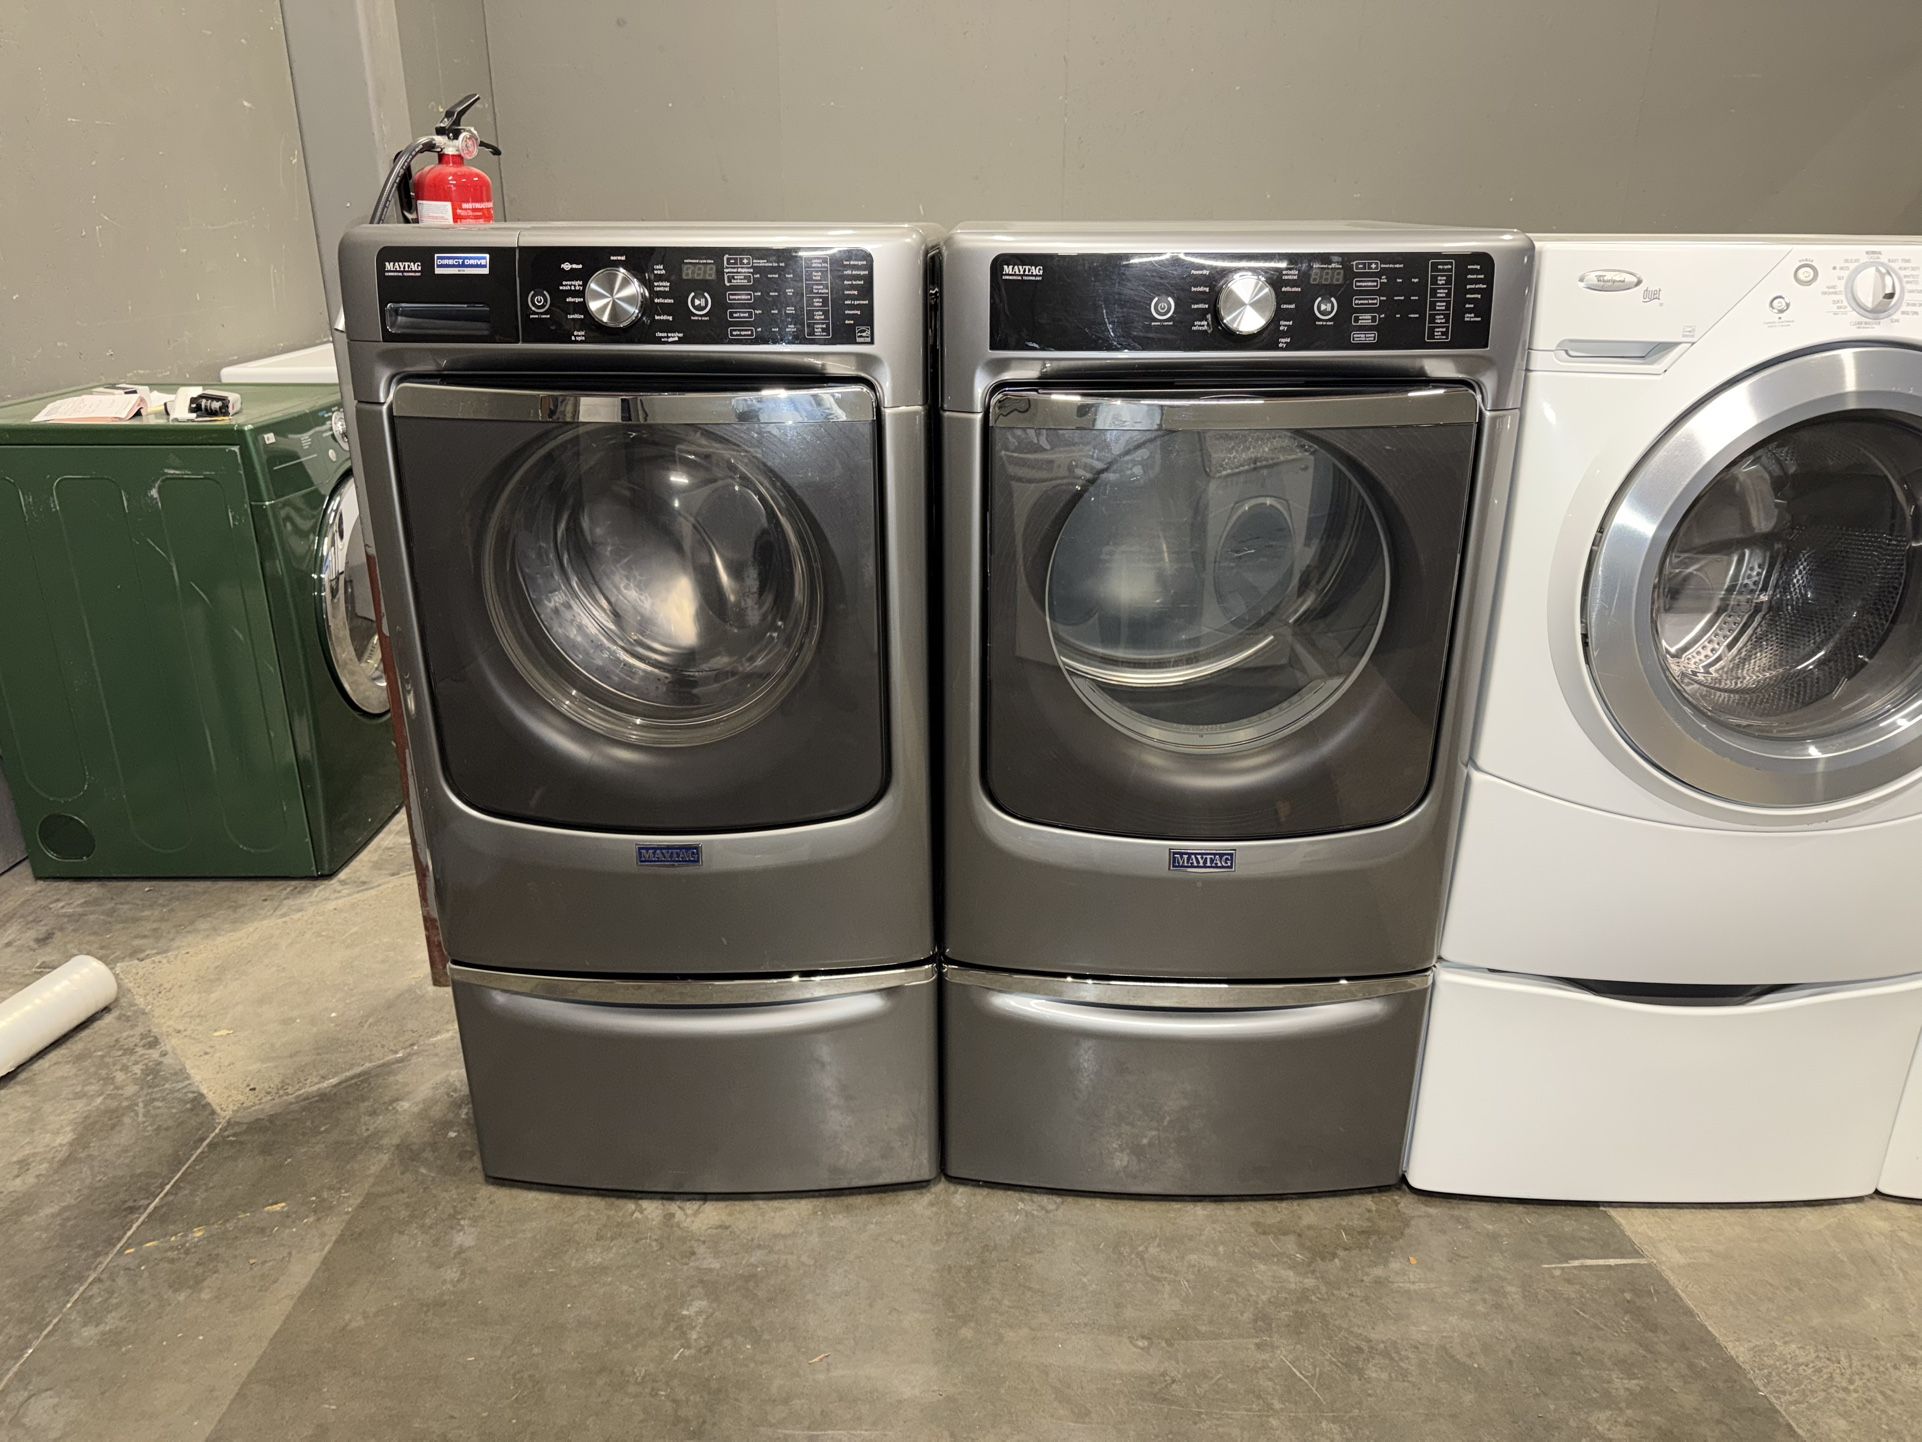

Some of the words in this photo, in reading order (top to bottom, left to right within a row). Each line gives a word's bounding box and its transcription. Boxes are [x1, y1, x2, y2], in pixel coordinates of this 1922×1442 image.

[385, 262, 421, 271] MAYTAG
[1002, 265, 1043, 275] MAYTAG
[1642, 286, 1662, 301] duet
[640, 849, 698, 861] MAYTAG
[1174, 854, 1231, 867] MAYTAG
